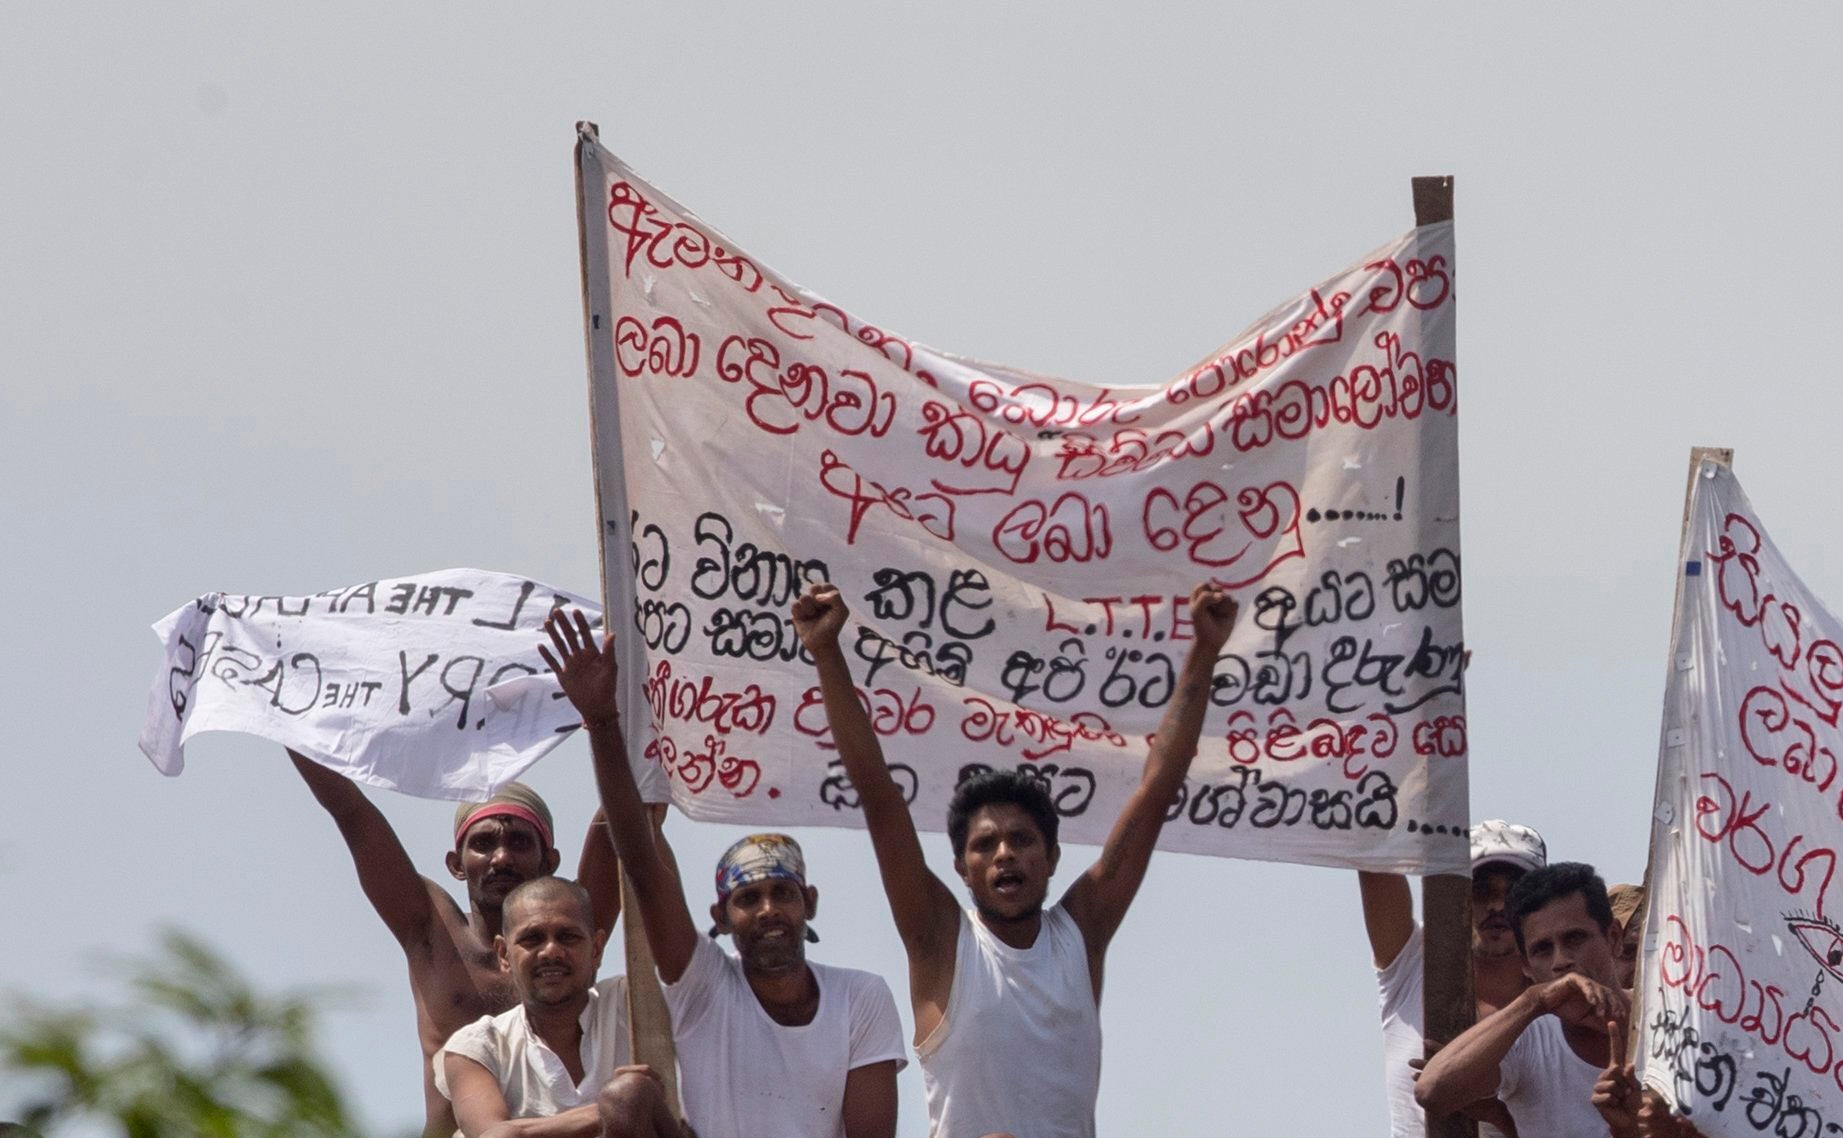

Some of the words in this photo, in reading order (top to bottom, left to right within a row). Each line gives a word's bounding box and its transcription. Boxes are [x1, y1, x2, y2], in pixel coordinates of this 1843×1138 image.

[616, 316, 699, 377] ලබා
[716, 335, 896, 435] දෙනවා
[994, 491, 1112, 564] ලබා
[705, 608, 816, 666] සමා
[1740, 686, 1837, 792] ලබා
